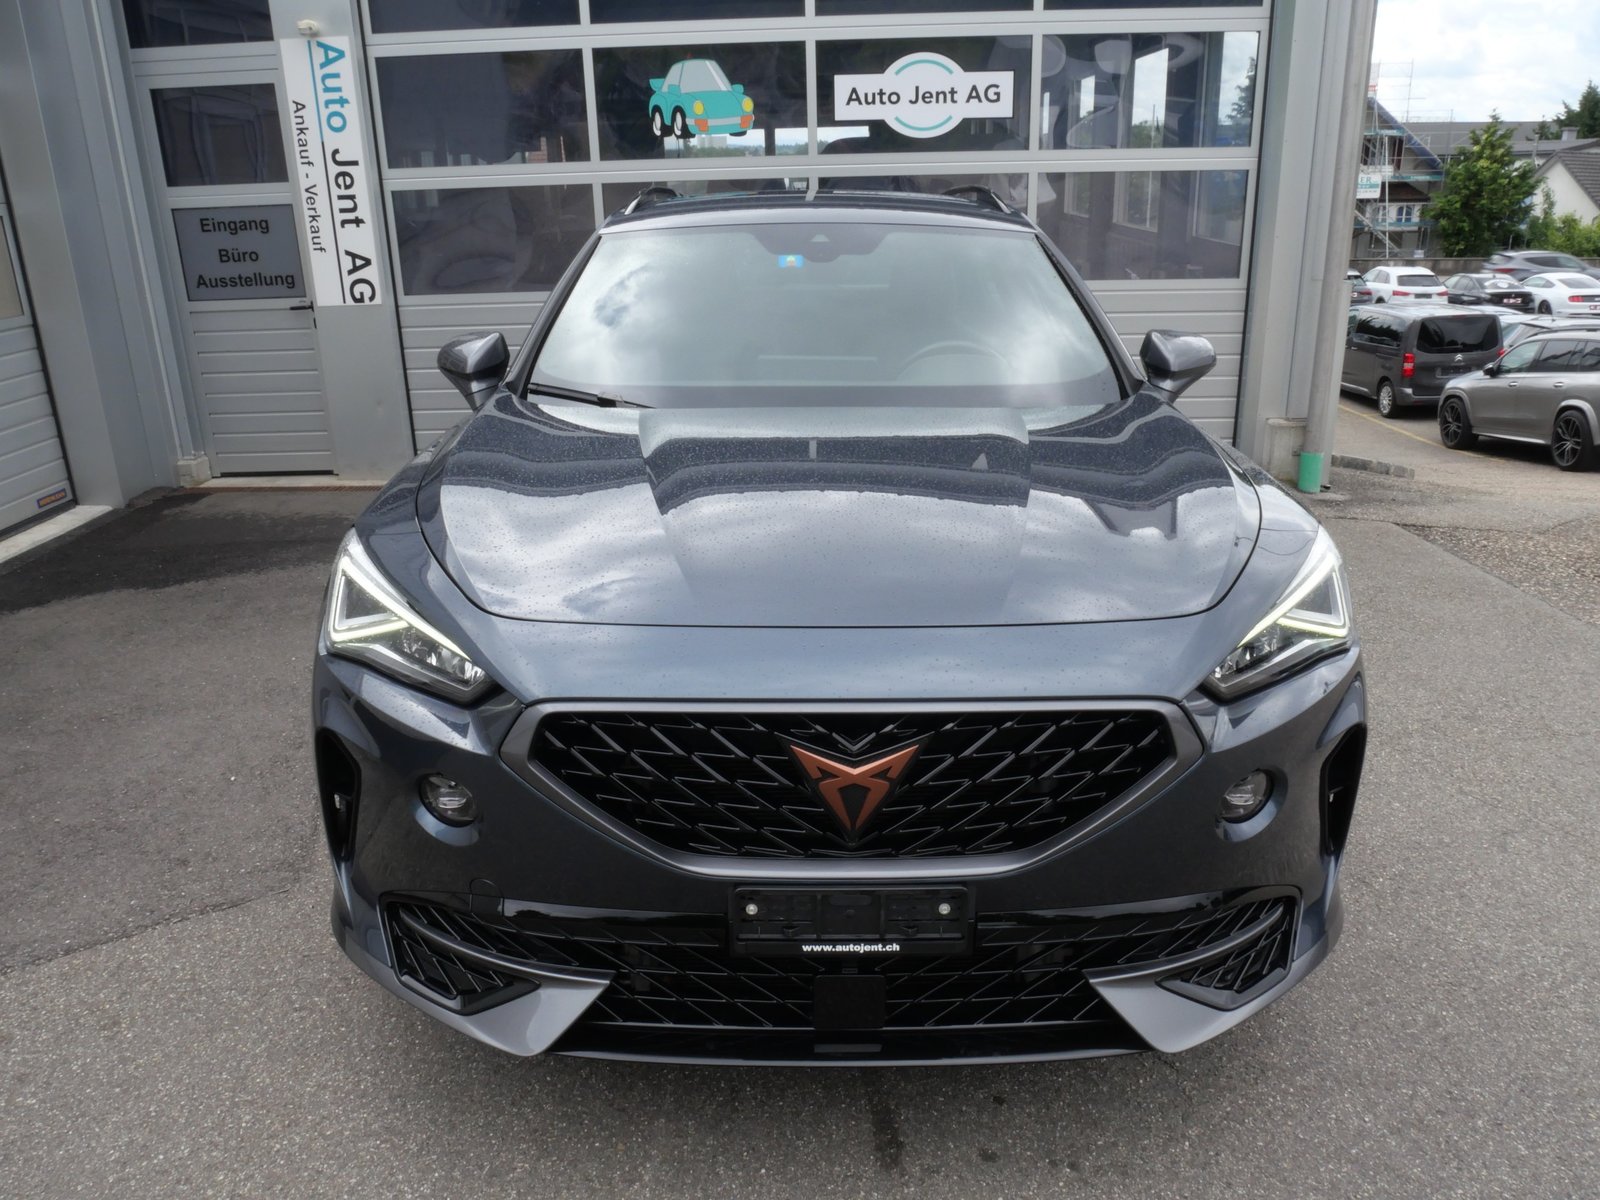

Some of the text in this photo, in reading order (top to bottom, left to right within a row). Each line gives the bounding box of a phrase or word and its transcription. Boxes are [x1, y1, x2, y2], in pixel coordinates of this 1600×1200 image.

[846, 84, 1001, 105] Auto Jent AG
[292, 100, 314, 167] Ankauf
[304, 184, 326, 253] Verkauf
[316, 40, 377, 304] Auto Jent AG
[199, 217, 270, 235] Eingang
[218, 247, 259, 264] Büro
[196, 272, 296, 290] Ausstellung
[802, 943, 900, 953] www.autojent.ch
